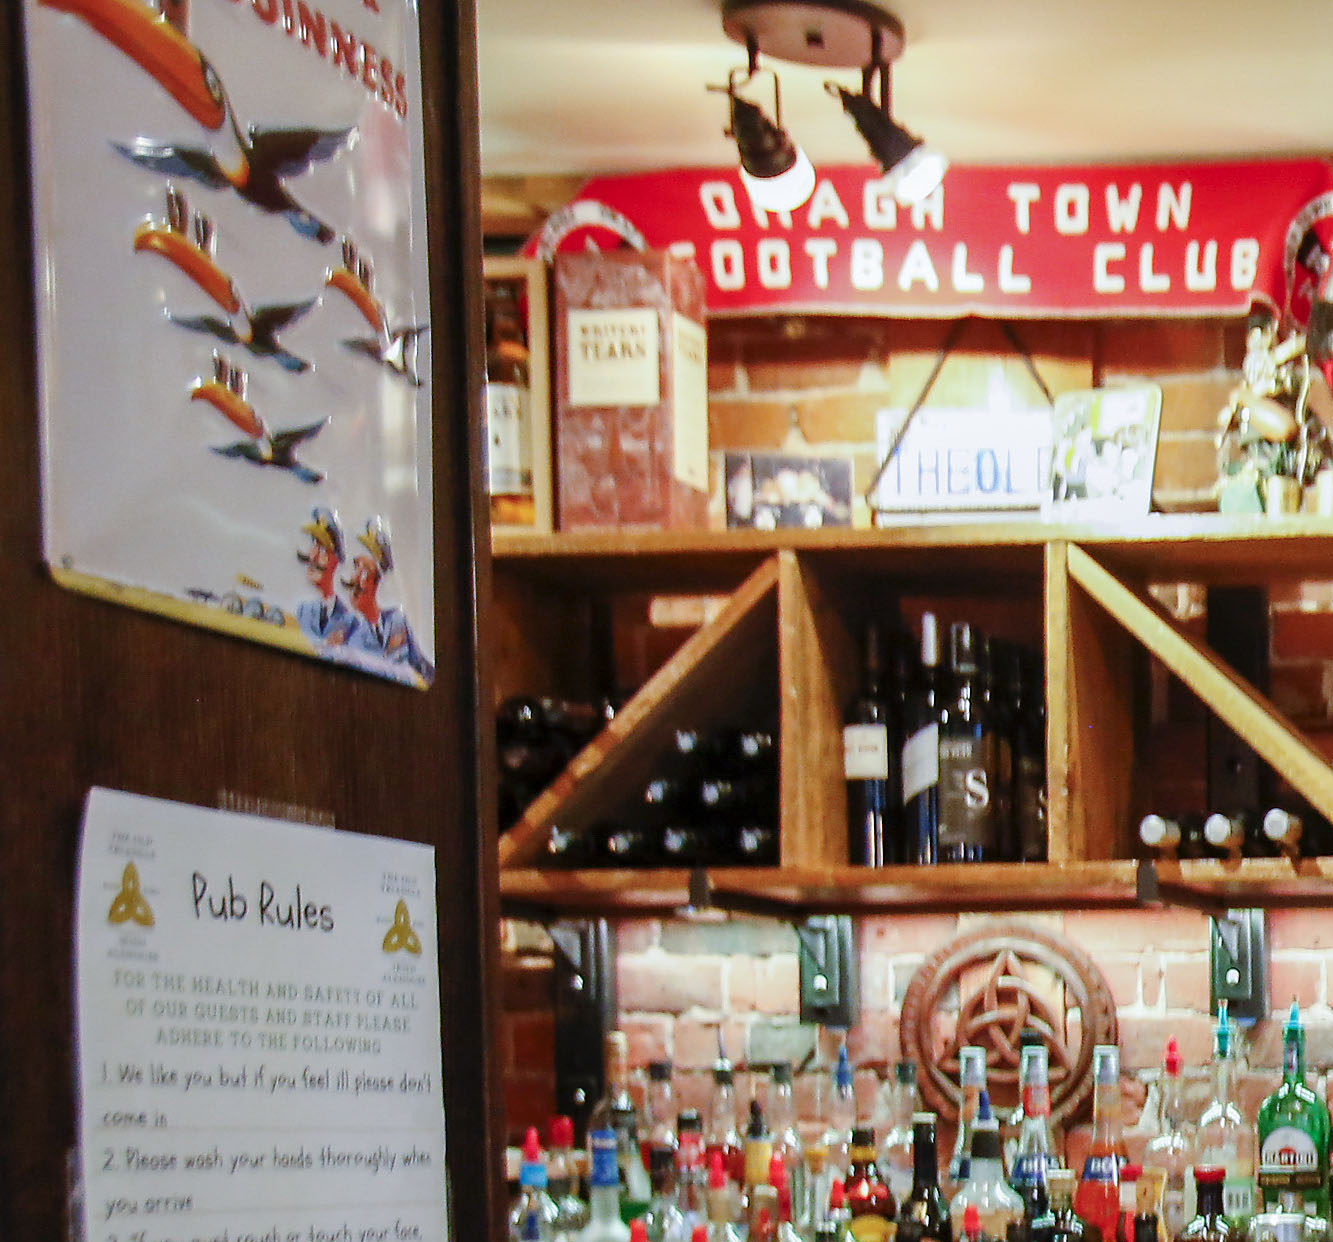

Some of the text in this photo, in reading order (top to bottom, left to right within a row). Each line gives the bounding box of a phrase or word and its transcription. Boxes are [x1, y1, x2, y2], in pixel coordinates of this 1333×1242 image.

[232, 0, 408, 120] UINNESS
[1006, 181, 1193, 236] TOWN
[669, 236, 1260, 295] OOTBALL CLUB
[192, 869, 334, 933] Pub Rules
[151, 970, 185, 994] THE
[191, 974, 259, 998] HEALTH
[266, 981, 299, 1002] AND
[265, 1008, 298, 1026] AND
[356, 1013, 411, 1033] PLEASE
[156, 1025, 382, 1055] ADHERE TO THE FOLLOWING
[118, 1062, 144, 1085] We
[150, 1062, 178, 1087] like
[184, 1069, 213, 1094] you
[218, 1062, 248, 1089] but
[270, 1071, 297, 1096] you
[301, 1064, 330, 1090] feel
[354, 1069, 394, 1097] please
[103, 1109, 169, 1129] come in
[126, 1146, 178, 1172] Please
[183, 1146, 224, 1171] wash
[230, 1153, 266, 1176] your
[272, 1144, 314, 1169] hands
[105, 1199, 139, 1223] you
